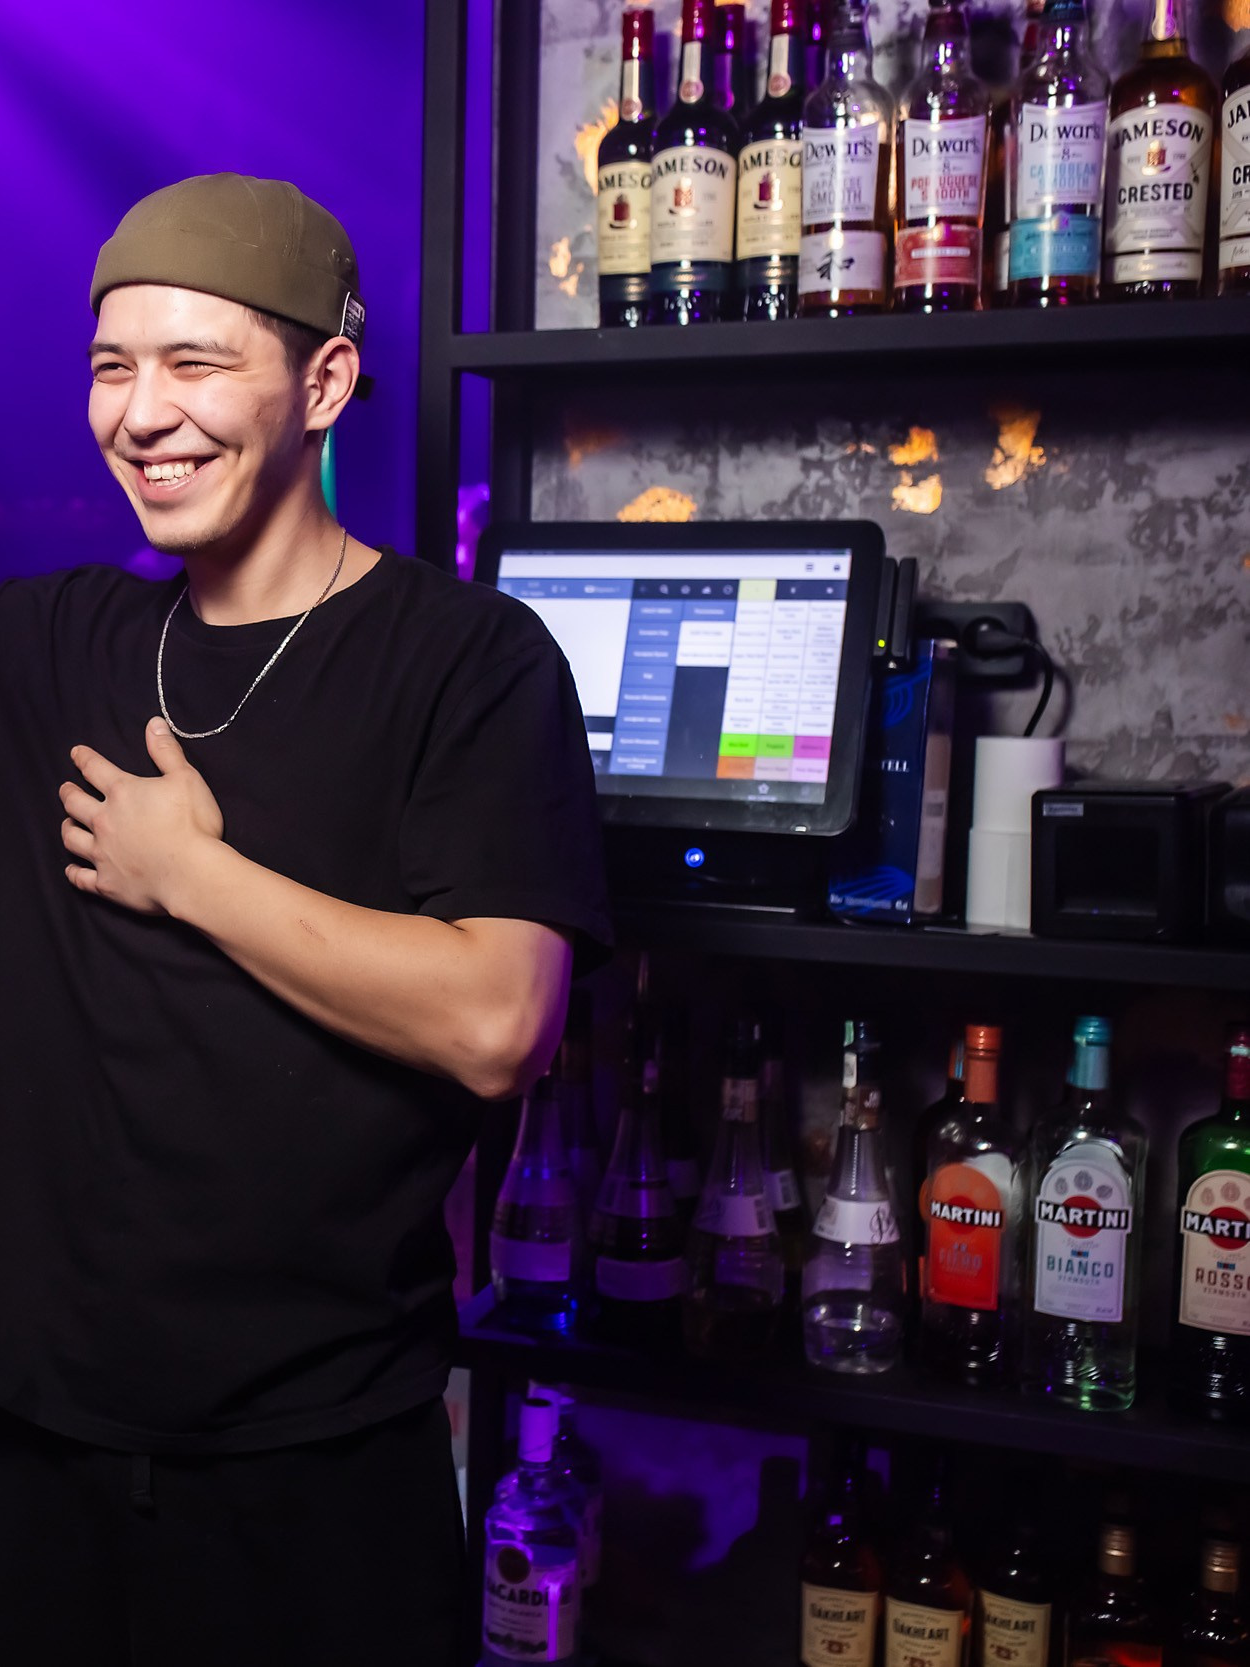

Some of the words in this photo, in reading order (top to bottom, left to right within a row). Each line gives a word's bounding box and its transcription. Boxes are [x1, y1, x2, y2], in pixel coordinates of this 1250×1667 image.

[1113, 119, 1204, 149] JAMESON
[1030, 163, 1097, 178] CAIBBEAN
[911, 175, 978, 190] PORUGUESE
[1118, 183, 1193, 204] CRESTED
[921, 188, 970, 201] SOOTH
[931, 1201, 1000, 1227] MARTINI
[1040, 1202, 1127, 1228] MARTINI
[1185, 1212, 1250, 1240] MARTI
[1047, 1255, 1115, 1279] BIANCO
[985, 1612, 1037, 1633] AKHEART
